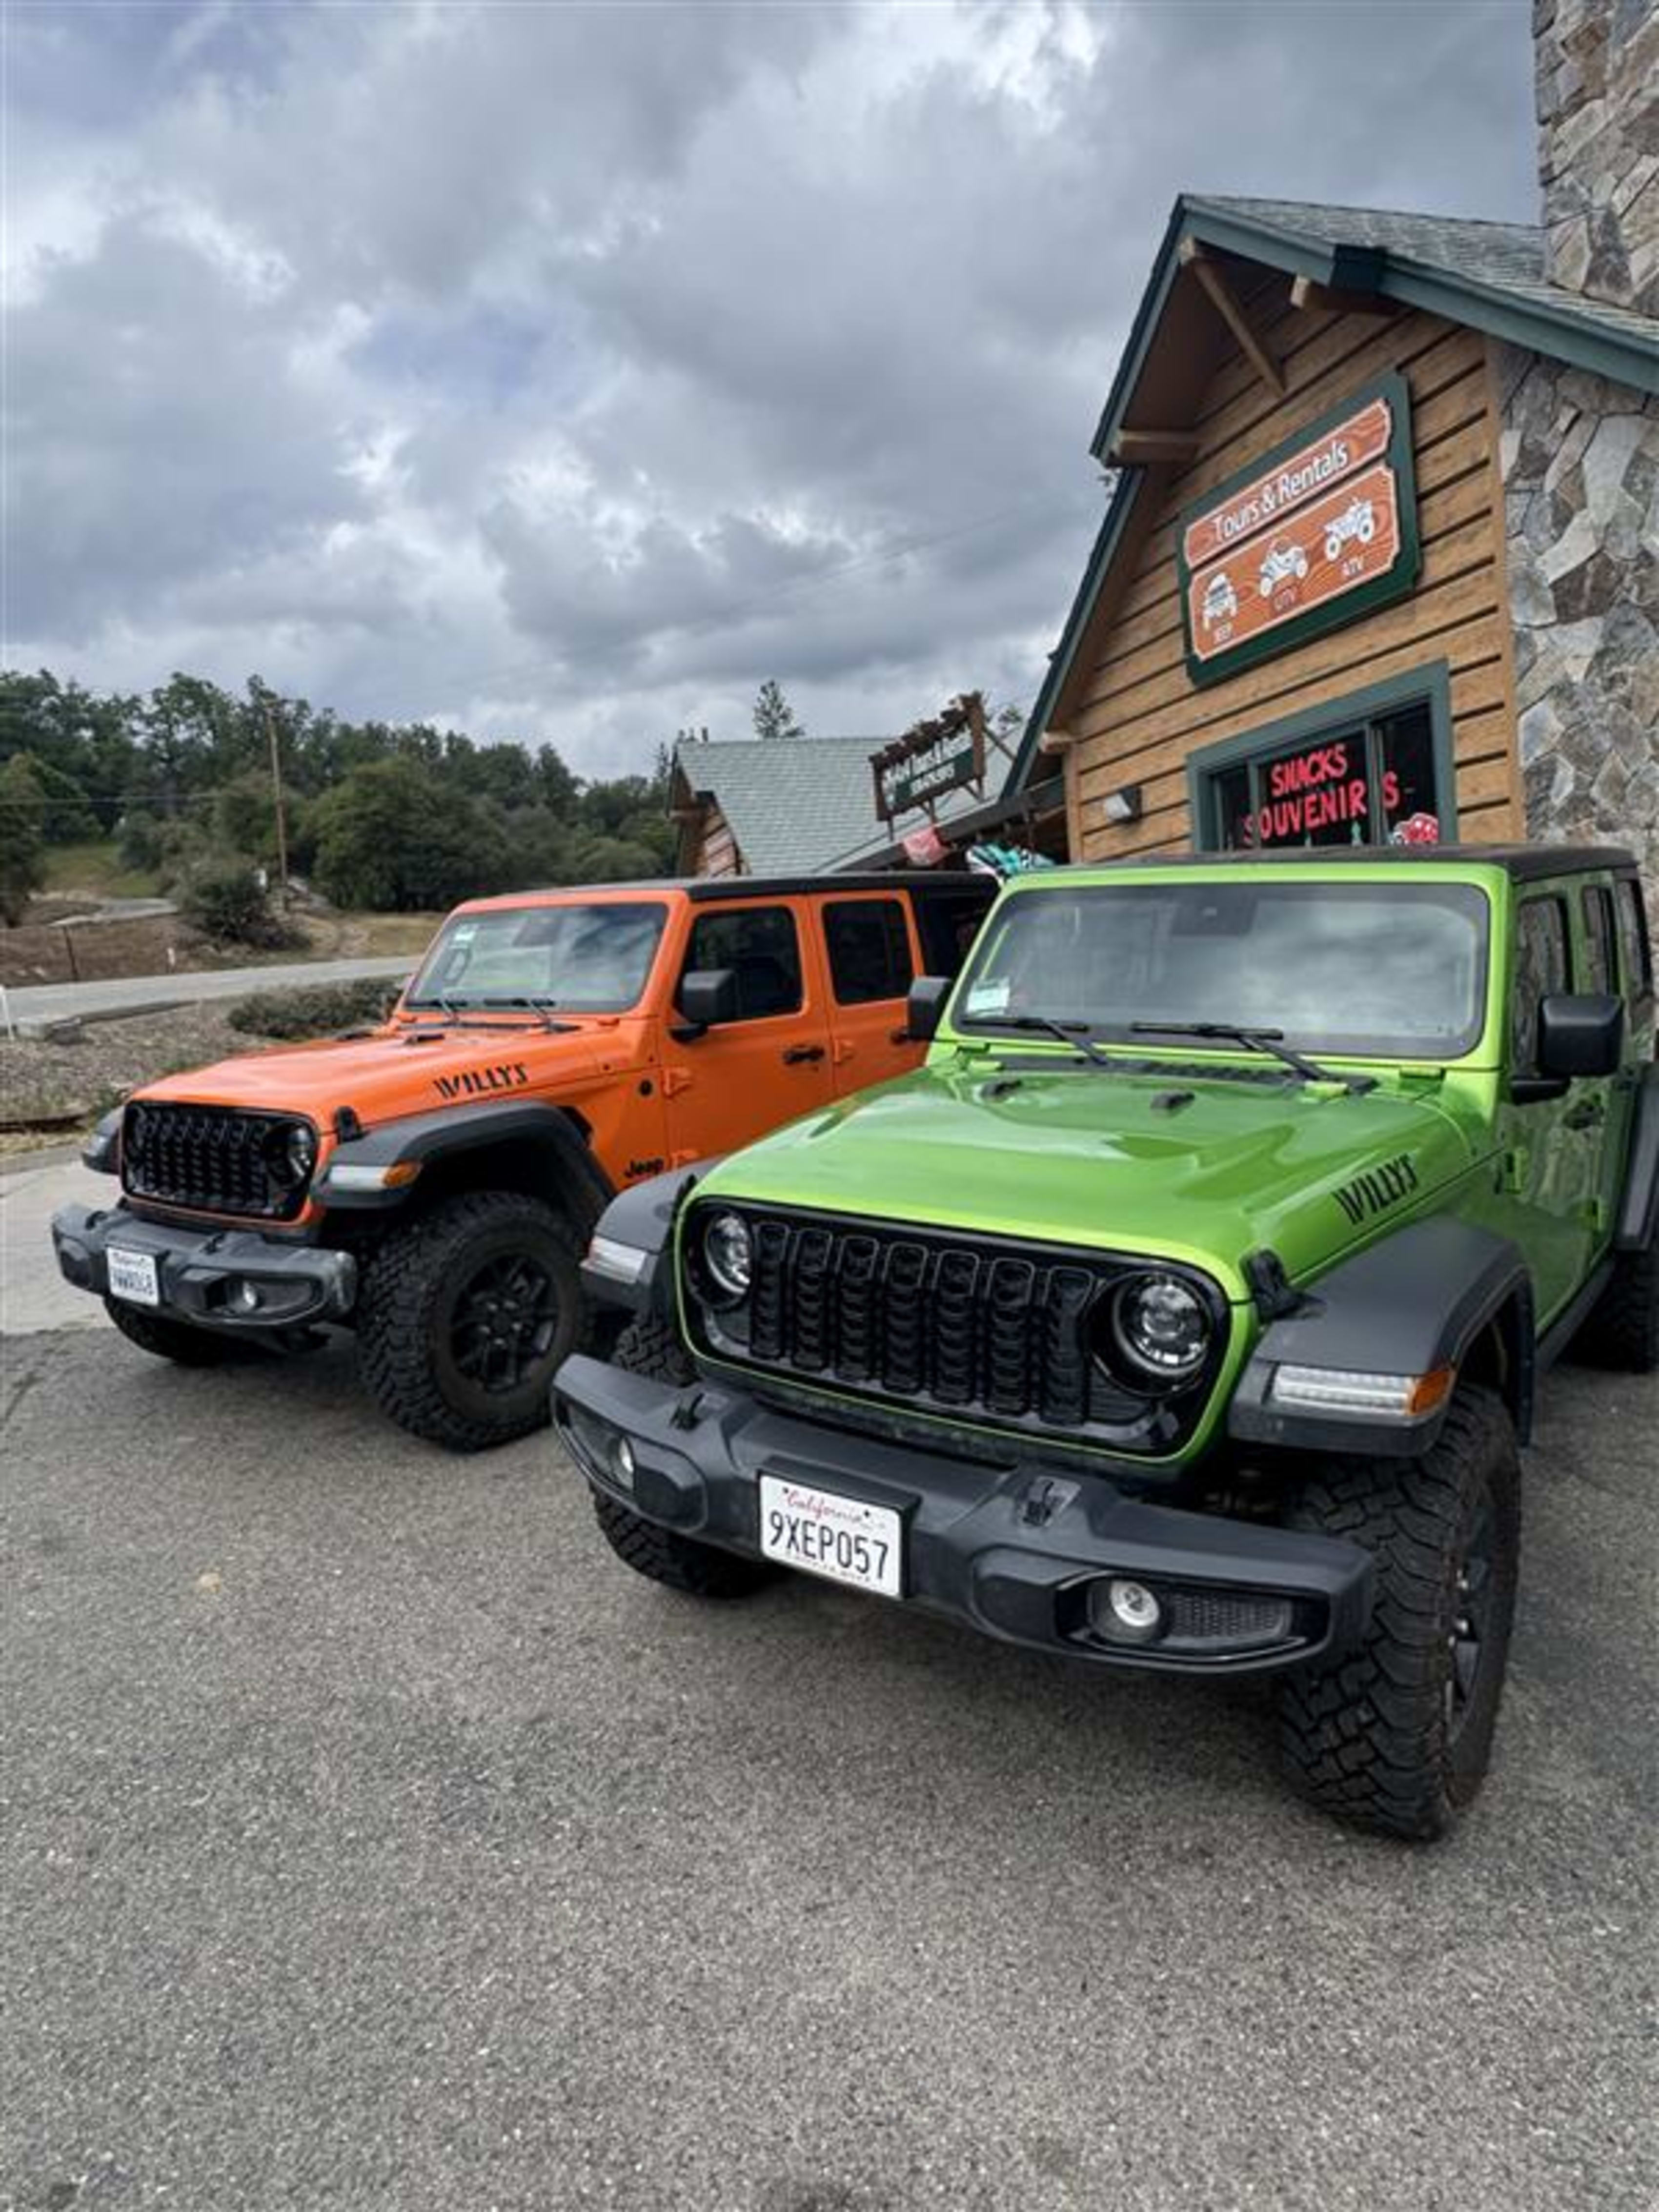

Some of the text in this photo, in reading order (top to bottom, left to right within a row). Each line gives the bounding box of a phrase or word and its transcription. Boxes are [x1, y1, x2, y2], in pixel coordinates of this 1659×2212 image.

[1211, 441, 1348, 542] Tours & Rentals
[1271, 743, 1349, 797] SNACKS
[433, 1062, 529, 1099] WILLYS
[624, 1157, 665, 1178] Jeep
[1330, 1153, 1418, 1226] WILLYS
[786, 1489, 863, 1523] California
[769, 1510, 889, 1579] 9XEP057
